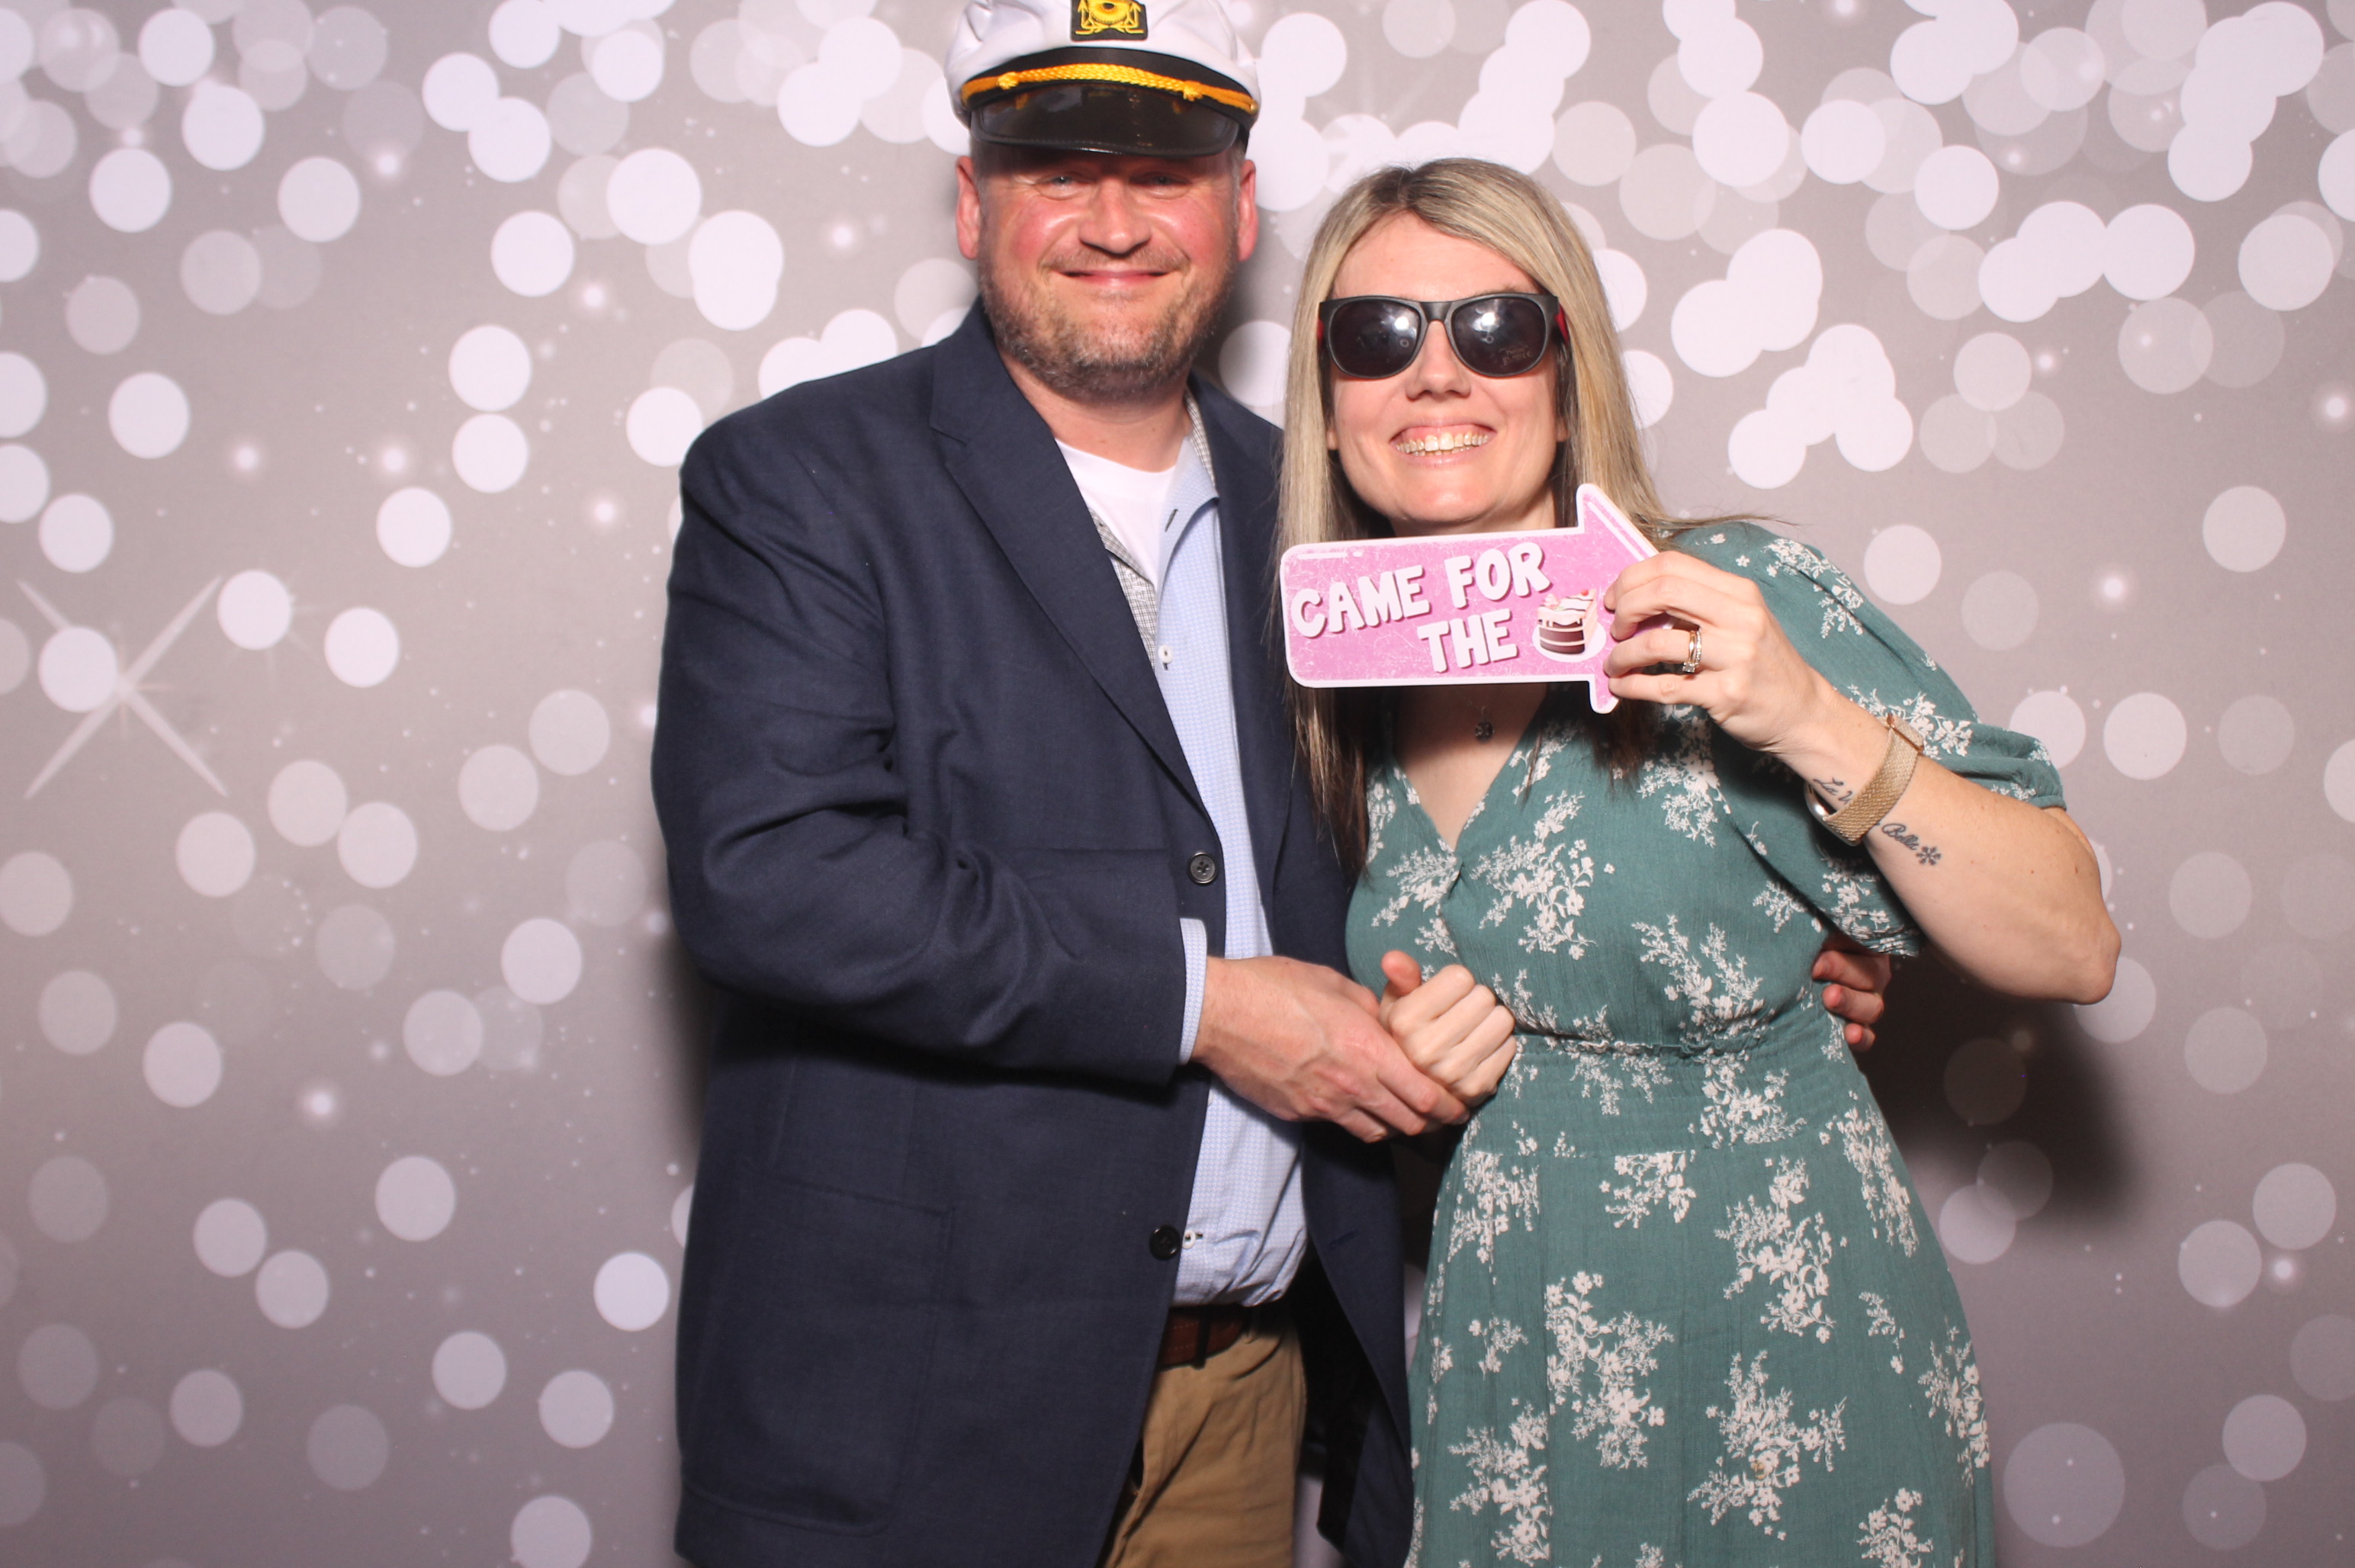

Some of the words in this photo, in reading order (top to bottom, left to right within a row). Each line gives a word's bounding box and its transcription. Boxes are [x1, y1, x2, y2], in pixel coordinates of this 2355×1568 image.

[1290, 564, 1431, 638] CAME
[1444, 541, 1551, 609] FOR
[1416, 608, 1518, 673] THE
[1881, 822, 1920, 851] Bella
